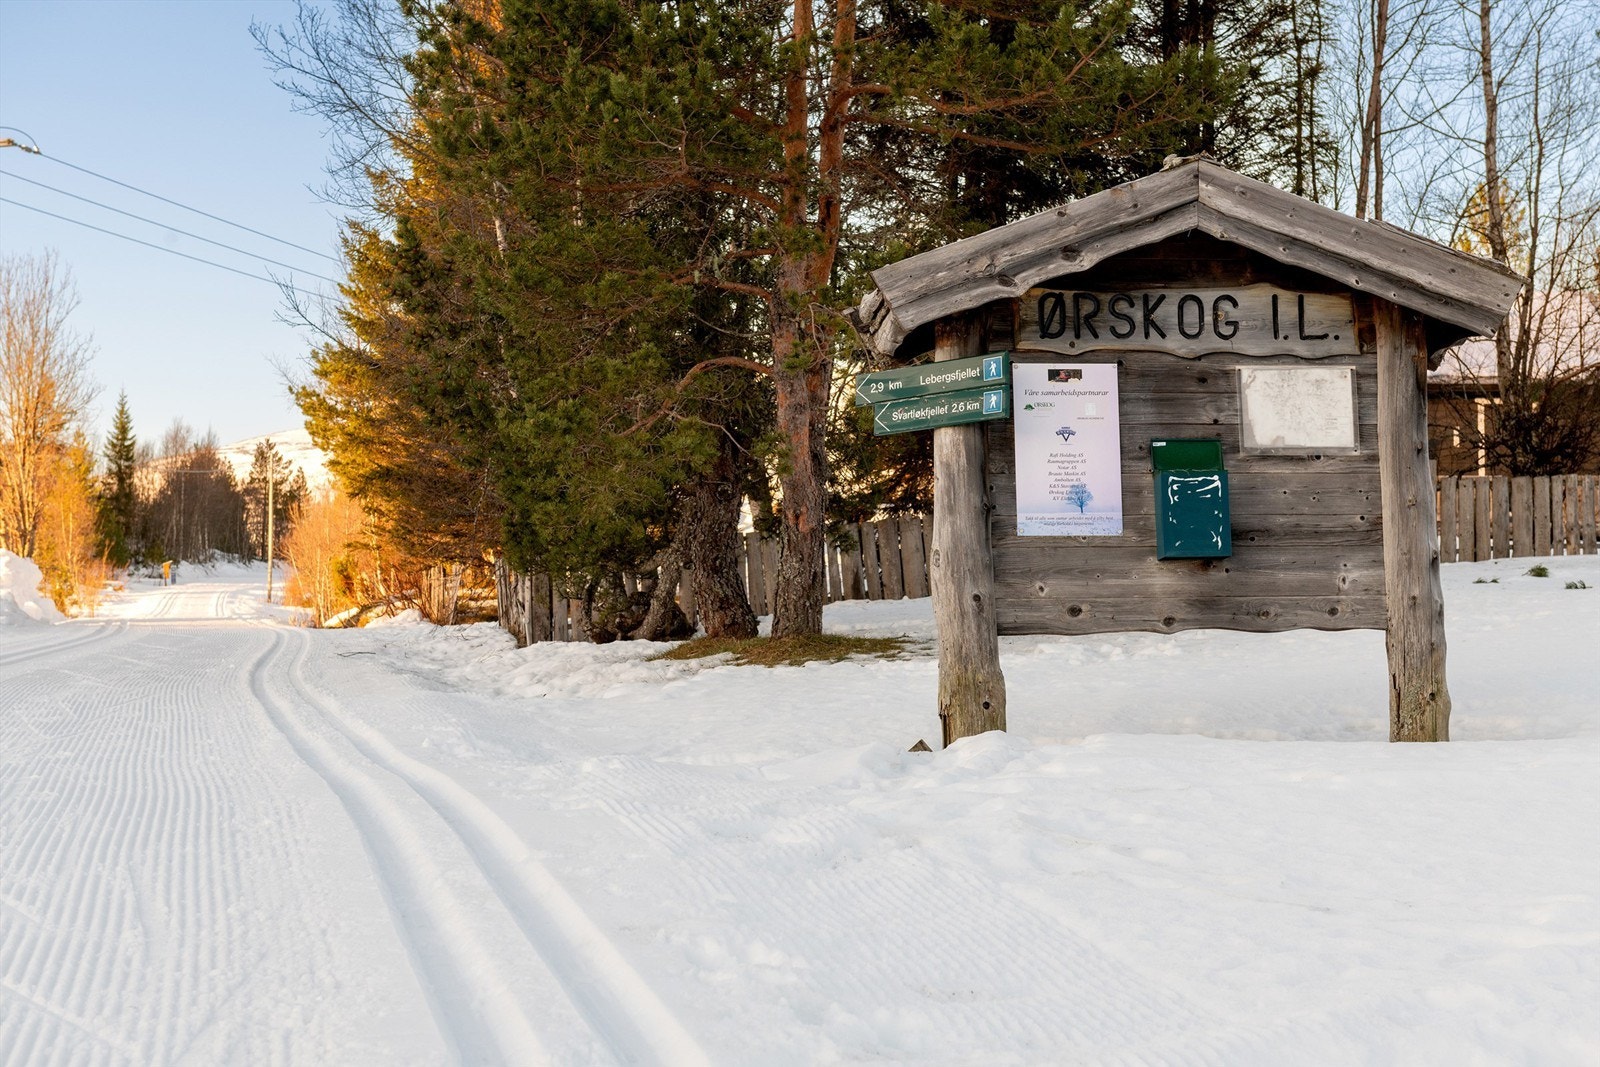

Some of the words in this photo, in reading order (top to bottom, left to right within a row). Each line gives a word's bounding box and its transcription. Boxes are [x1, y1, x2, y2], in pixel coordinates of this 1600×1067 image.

[1038, 292, 1240, 341] ØRSKOG
[1271, 293, 1340, 341] I.L.
[888, 381, 902, 391] km
[919, 367, 980, 386] Lebergsfjellet
[1040, 389, 1109, 398] samarbeidspartnarar
[966, 401, 980, 411] km
